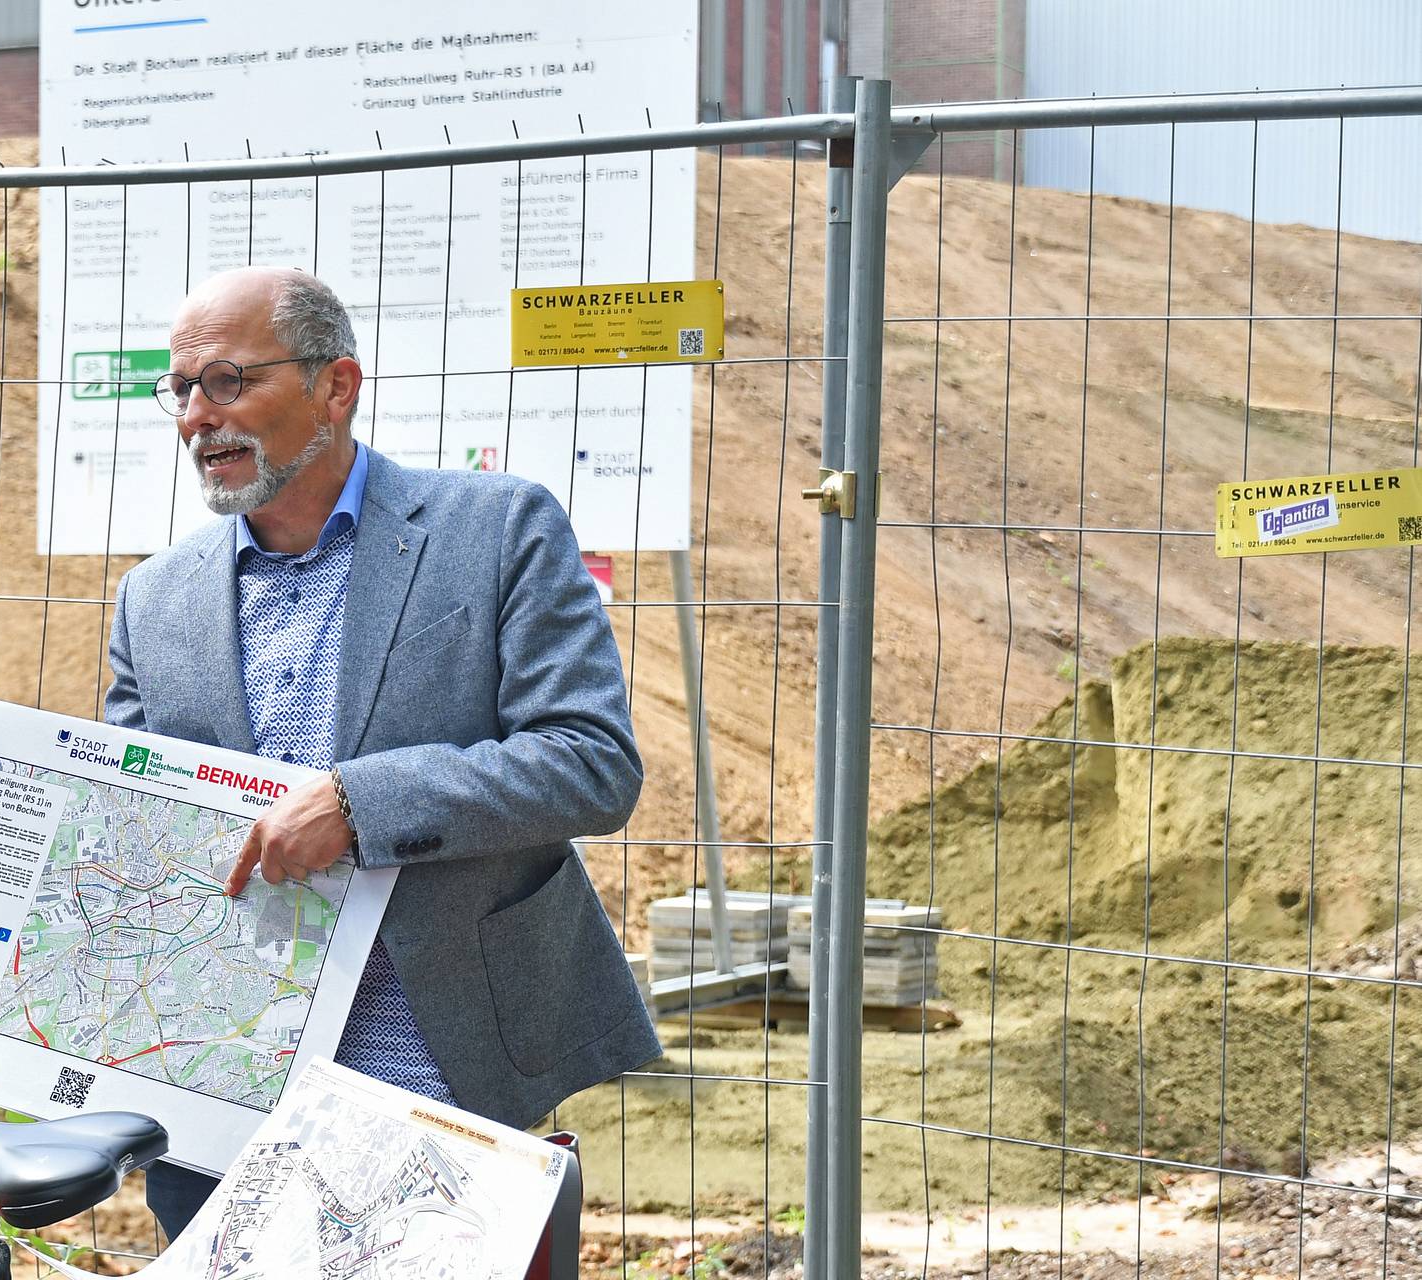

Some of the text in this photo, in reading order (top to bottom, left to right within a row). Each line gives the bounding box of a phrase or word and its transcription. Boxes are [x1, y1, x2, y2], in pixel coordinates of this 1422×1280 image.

[75, 32, 539, 76] Die Stadt Bochum realisiert auf dieser Fläche die Maßnahmen:
[363, 73, 457, 88] Radschnellweg
[362, 86, 563, 110] Grünzug Untere Stahlindustrie
[596, 168, 639, 181] Firma
[522, 291, 684, 309] SCHWARZFELLER
[579, 308, 633, 316] Bauzäune
[538, 348, 558, 356] 02173
[563, 347, 585, 355] 8904-0
[593, 453, 634, 462] STADT
[593, 466, 653, 477] BOCHUM
[1231, 476, 1401, 501] SCHWARZFELLER
[1336, 500, 1381, 510] unservice
[1306, 532, 1385, 544] www.schwarzfeller.de
[73, 737, 108, 753] STADT
[70, 748, 120, 769] BOCHUM
[150, 752, 163, 762] RS1
[146, 767, 162, 778] Ruhr
[148, 761, 195, 779] Radschnellweg
[196, 764, 289, 799] BERNARD
[28, 784, 45, 796] zum
[4, 788, 21, 801] Ruhr
[22, 790, 36, 805] (RS
[36, 794, 44, 808] 1)
[44, 798, 52, 809] in
[241, 794, 274, 808] GRUP
[1, 801, 15, 811] von
[16, 802, 46, 819] Bochum
